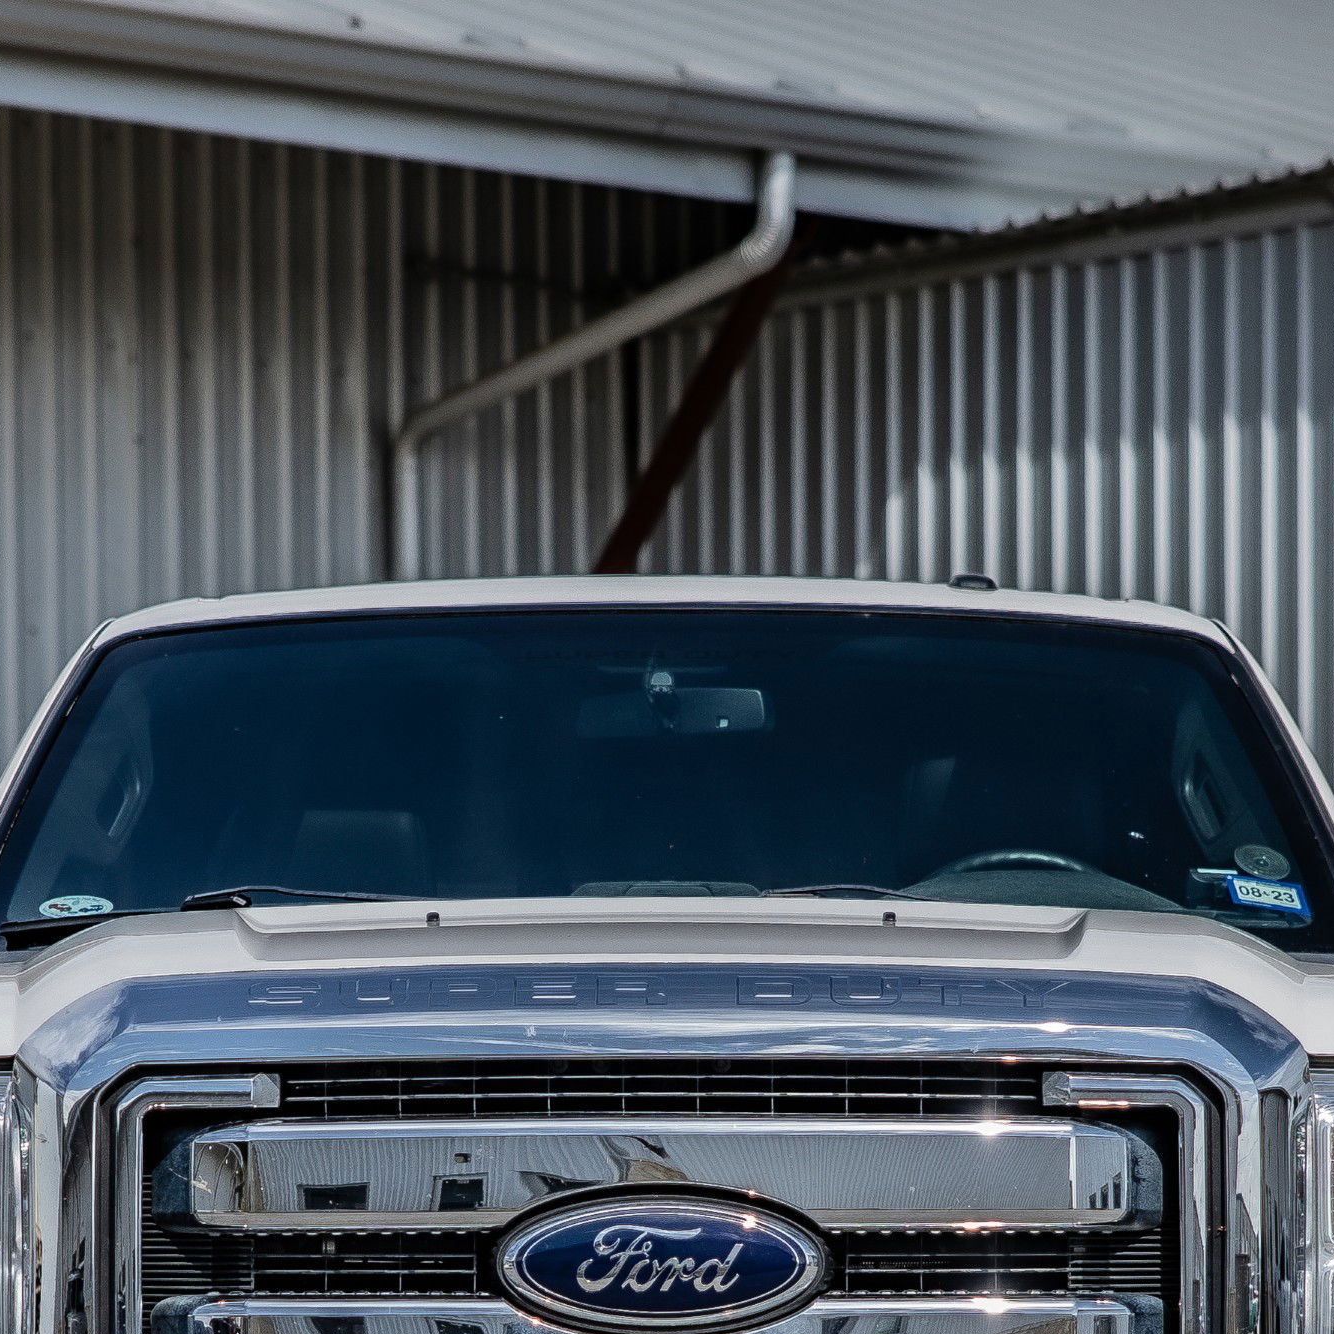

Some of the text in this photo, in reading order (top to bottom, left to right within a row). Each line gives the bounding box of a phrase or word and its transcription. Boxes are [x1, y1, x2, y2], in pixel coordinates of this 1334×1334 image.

[248, 975, 1070, 1008] SUPER DUTY
[576, 1225, 744, 1292] Ford
